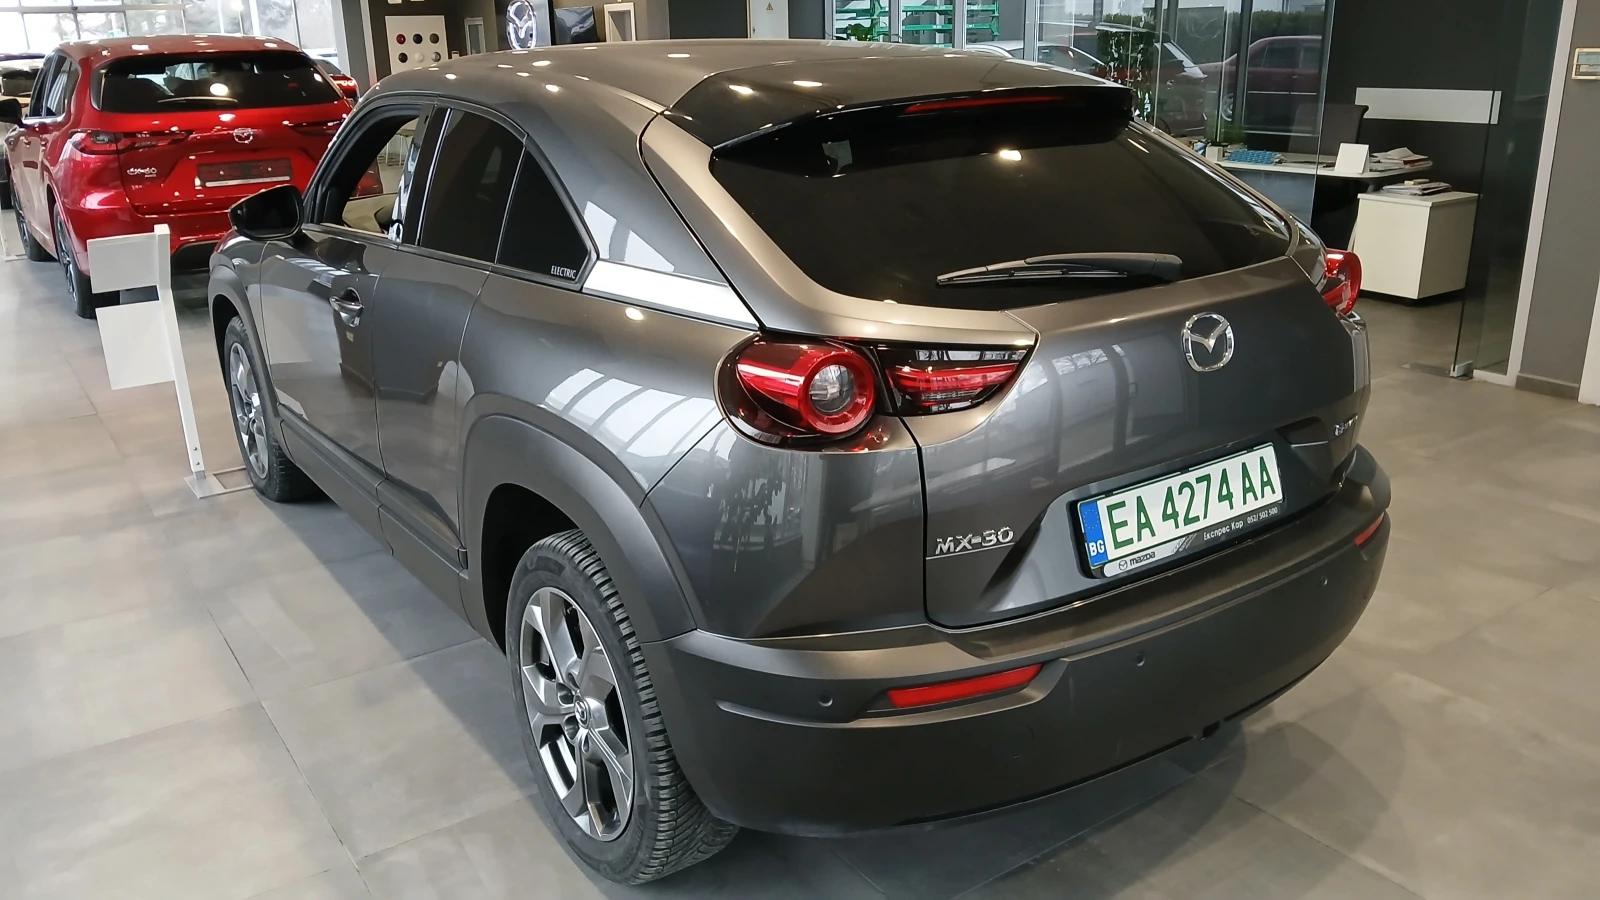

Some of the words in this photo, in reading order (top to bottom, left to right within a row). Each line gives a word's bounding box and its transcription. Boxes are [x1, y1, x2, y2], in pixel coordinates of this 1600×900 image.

[551, 265, 577, 279] ELECTRIC
[1106, 495, 1156, 550] EA
[1162, 468, 1234, 529] 4274
[1241, 456, 1276, 506] AA
[935, 526, 1014, 555] MX-30
[1203, 525, 1230, 541] Експрес
[1089, 540, 1105, 557] BG
